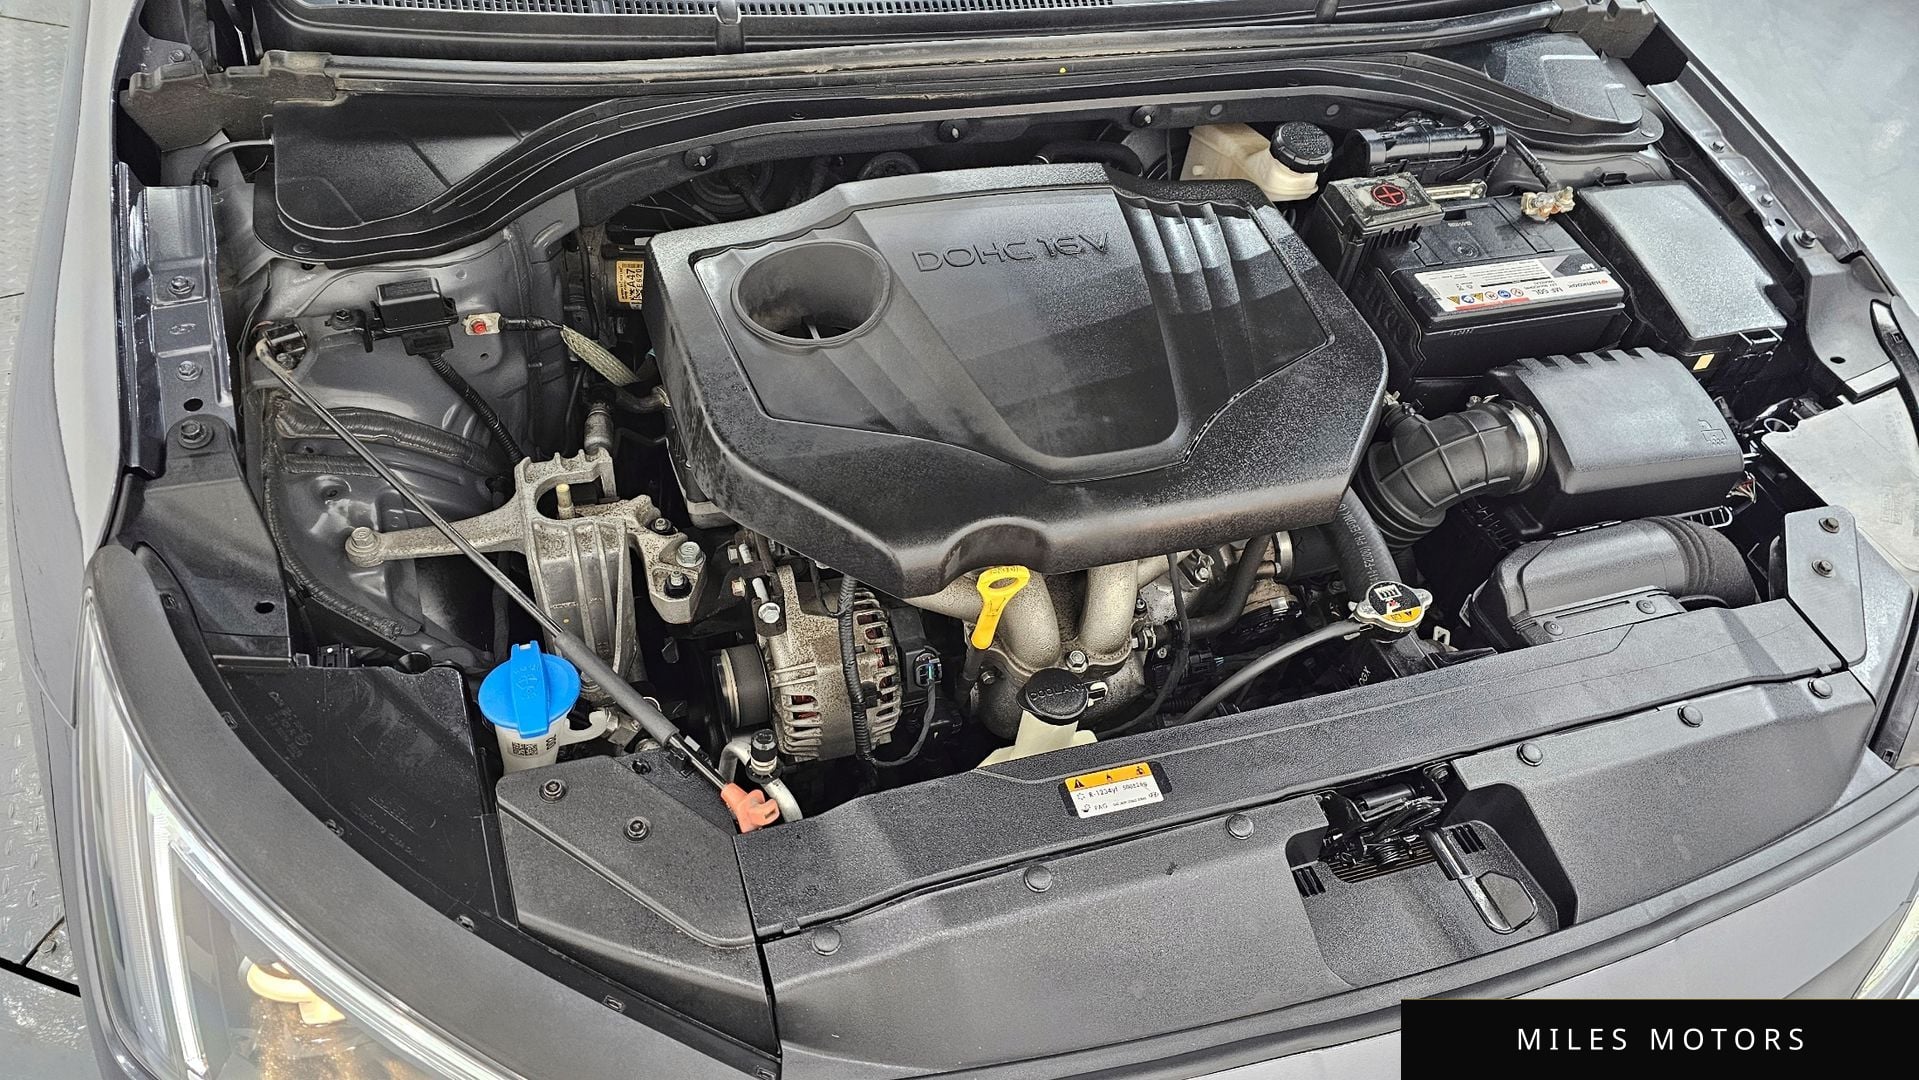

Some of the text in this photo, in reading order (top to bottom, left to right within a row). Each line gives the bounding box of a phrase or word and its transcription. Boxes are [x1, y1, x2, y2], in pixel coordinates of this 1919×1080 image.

[911, 232, 1108, 272] DOHC 16V
[1030, 683, 1084, 701] COOLANT
[1088, 786, 1118, 797] R-1234yf
